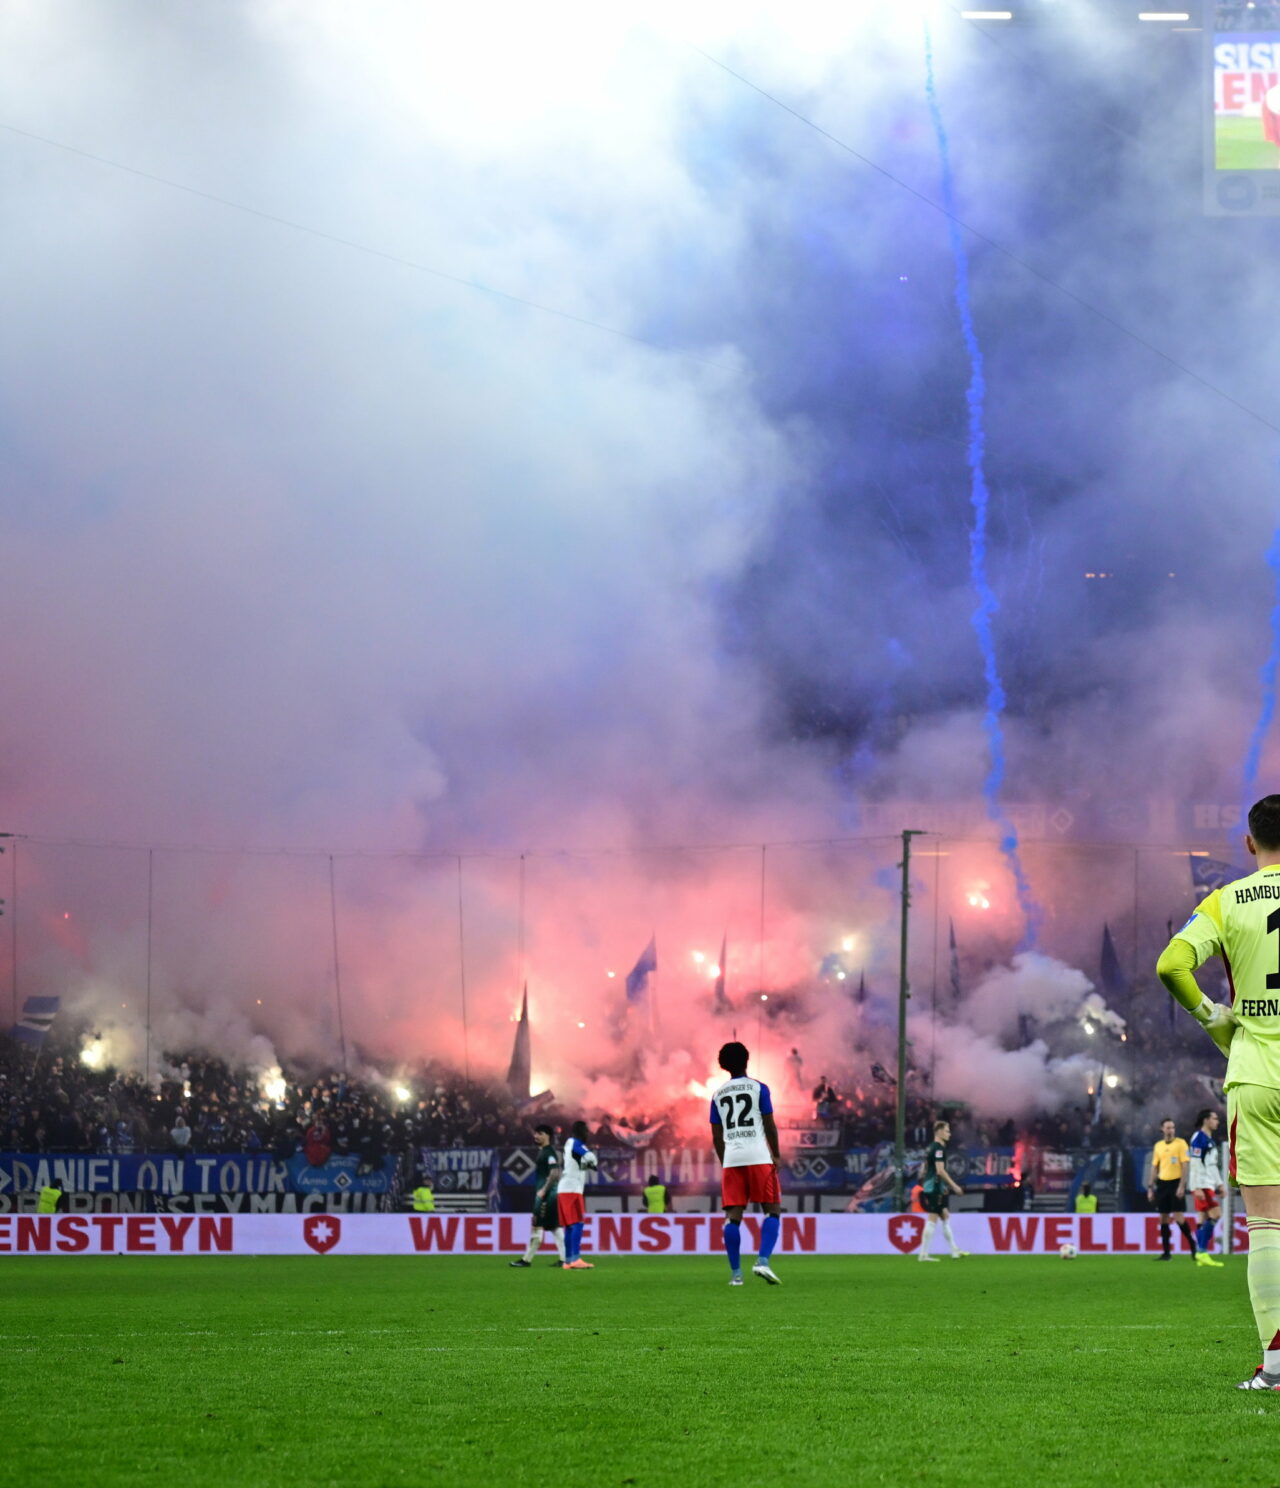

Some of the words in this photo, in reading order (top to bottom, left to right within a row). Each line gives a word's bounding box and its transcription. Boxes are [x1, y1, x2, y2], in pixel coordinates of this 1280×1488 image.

[720, 1093, 754, 1130] 22
[137, 1158, 184, 1194] ON
[196, 1158, 289, 1193] TOUR
